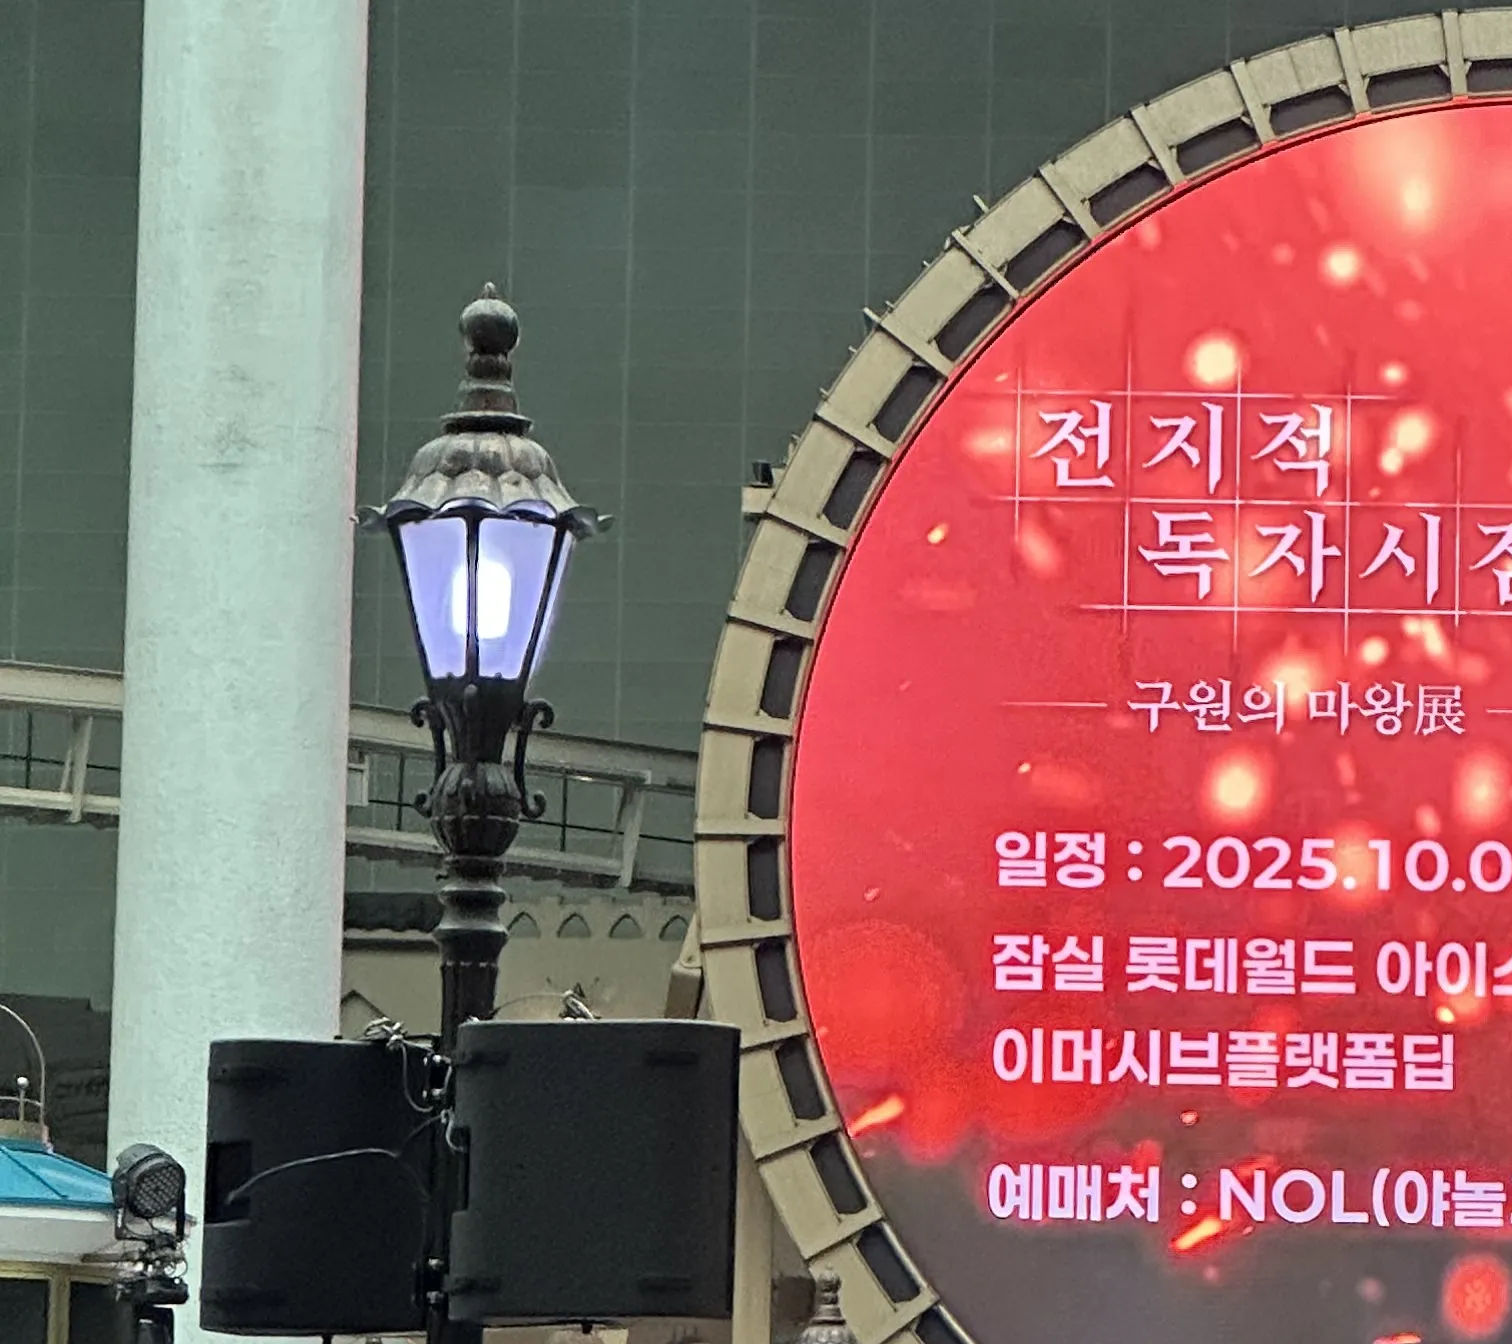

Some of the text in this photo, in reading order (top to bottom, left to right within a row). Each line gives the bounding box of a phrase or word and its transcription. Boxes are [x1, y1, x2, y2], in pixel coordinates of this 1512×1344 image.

[1127, 677, 1286, 736] 구원의
[994, 831, 1107, 890] 일정
[992, 935, 1105, 994] 잠실
[1125, 936, 1356, 996] 롯데월드
[993, 1028, 1456, 1092] 이머시브플랫폼딥
[987, 1163, 1162, 1224] 예매처
